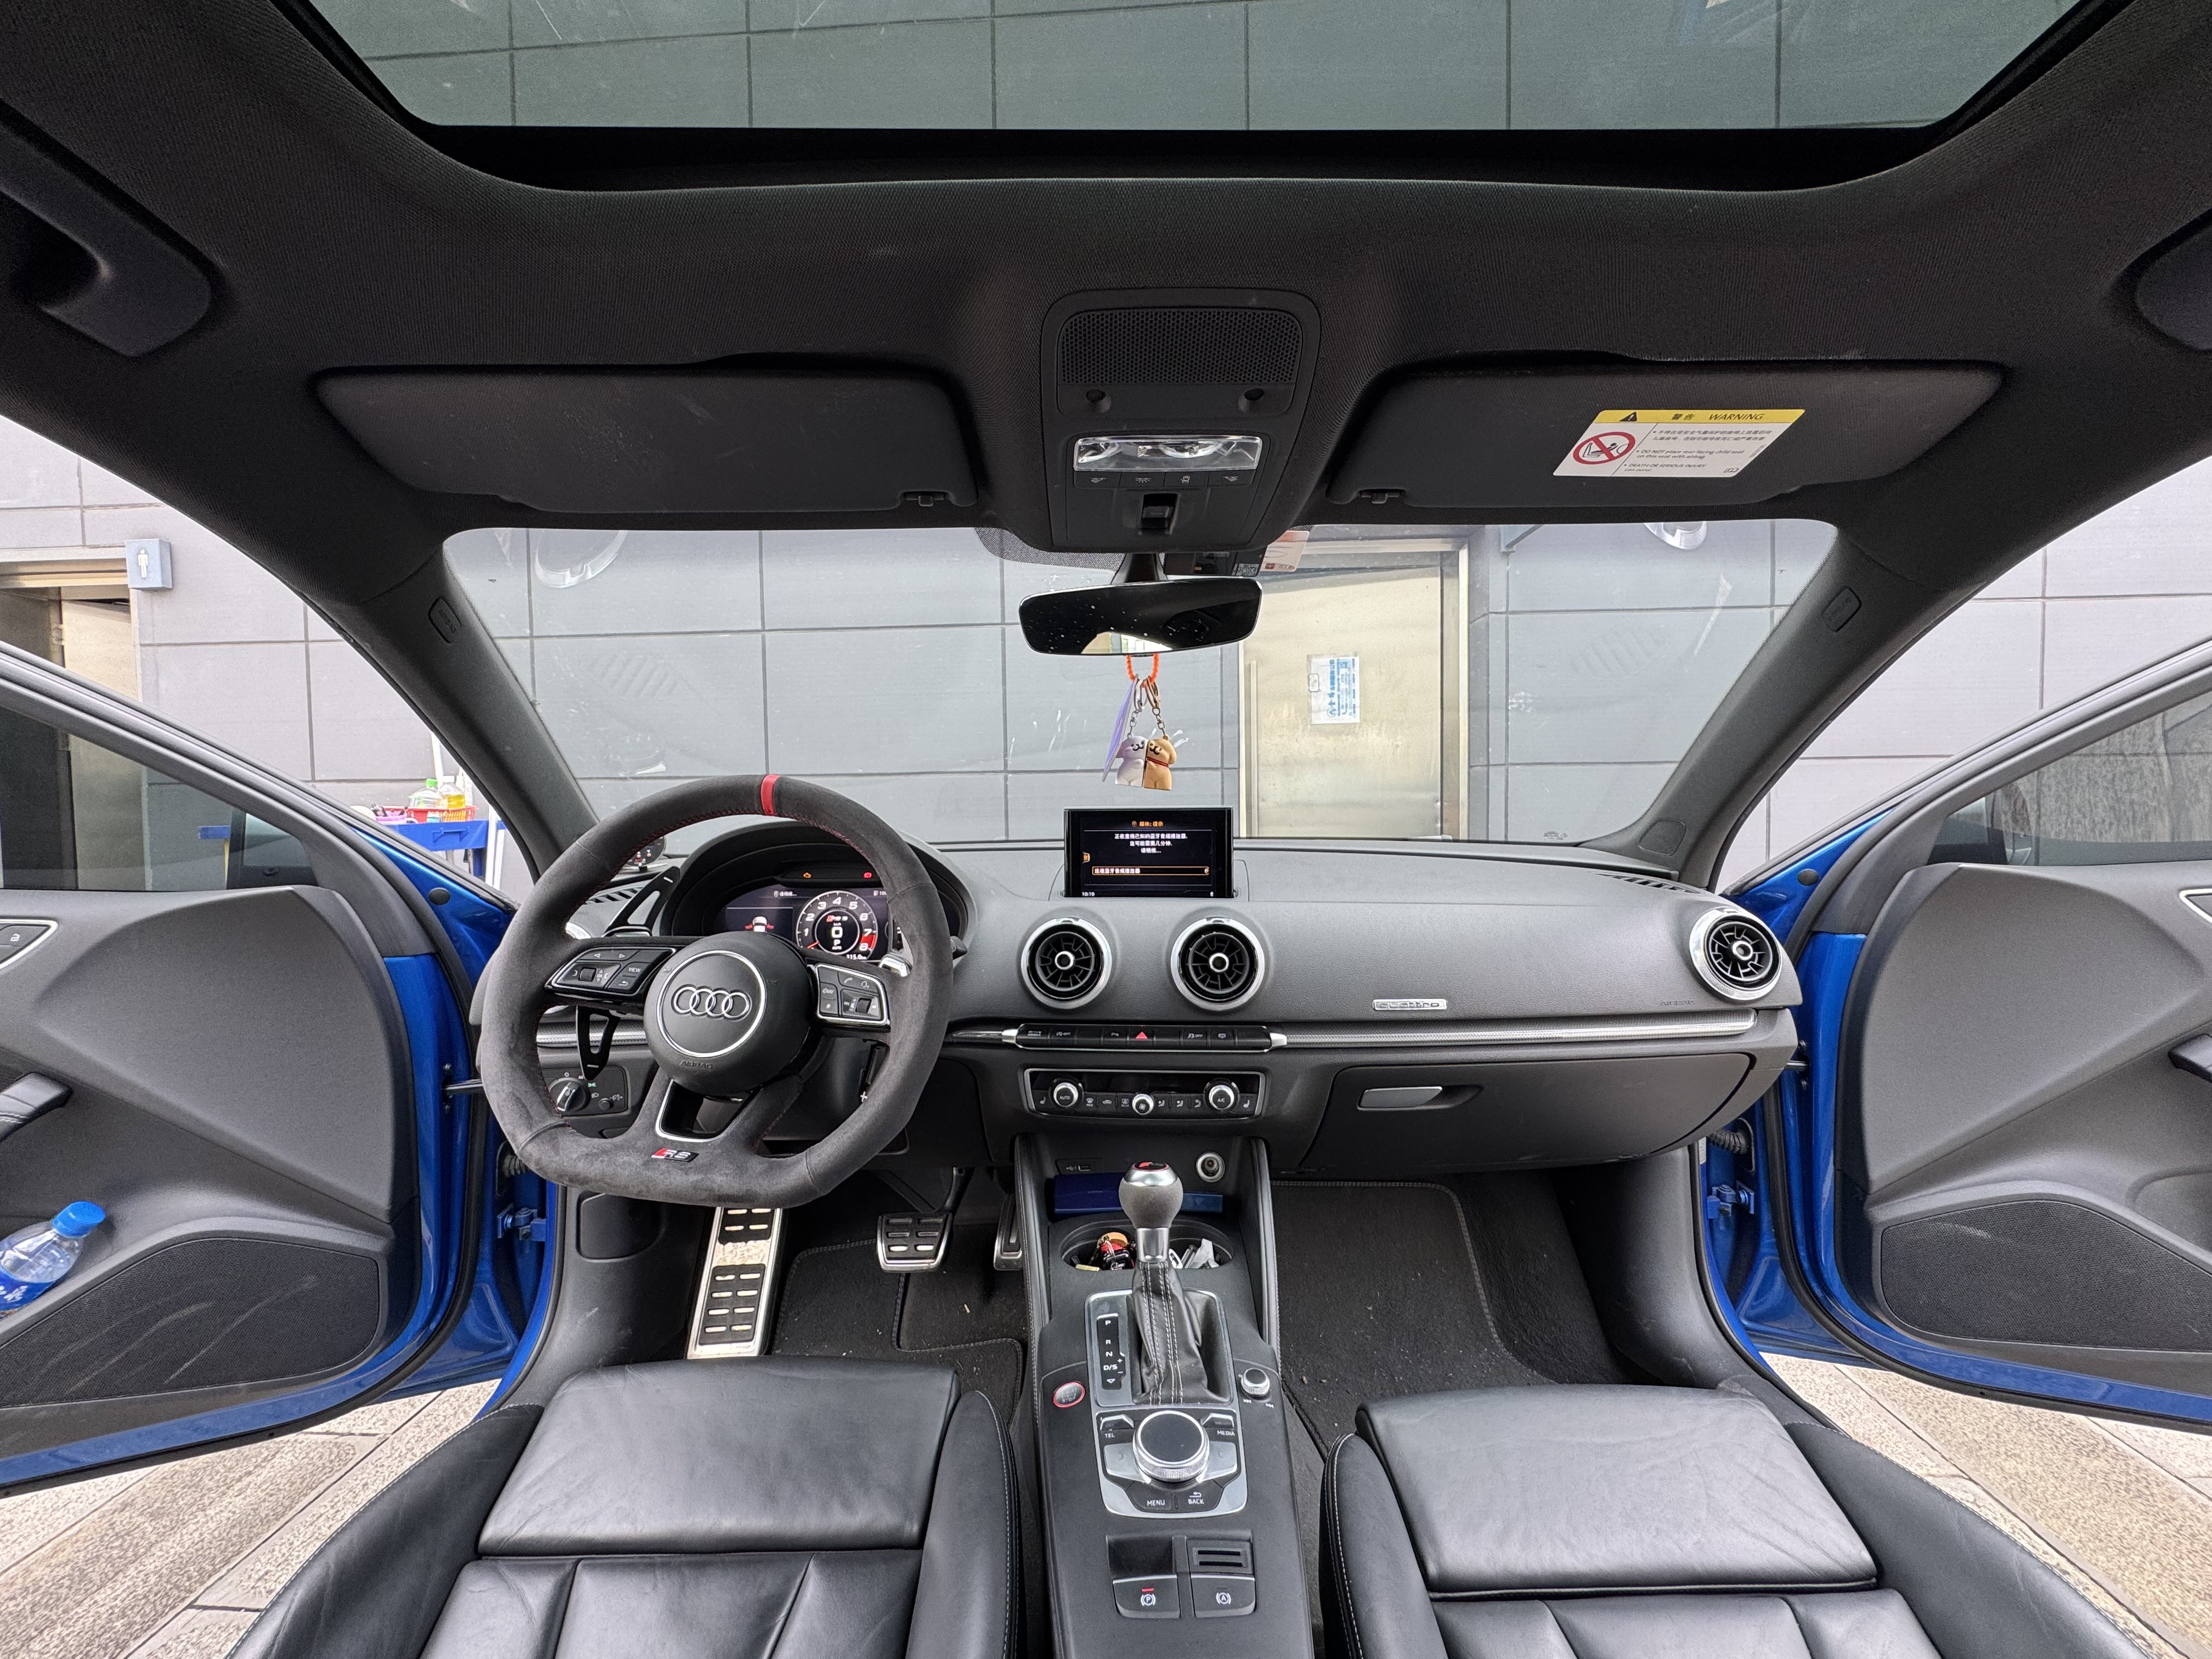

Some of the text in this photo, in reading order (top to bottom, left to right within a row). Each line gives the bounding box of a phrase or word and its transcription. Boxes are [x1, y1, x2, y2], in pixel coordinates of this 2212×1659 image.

[833, 896, 842, 905] 4
[817, 901, 827, 910] 3
[849, 901, 858, 910] 5
[805, 913, 815, 921] 2
[859, 913, 869, 921] 6
[804, 928, 809, 936] 1
[832, 926, 843, 938] 0
[864, 928, 872, 936] 7
[859, 943, 869, 951] 8
[1379, 1001, 1440, 1009] quattro
[680, 1060, 713, 1069] AIRBAG
